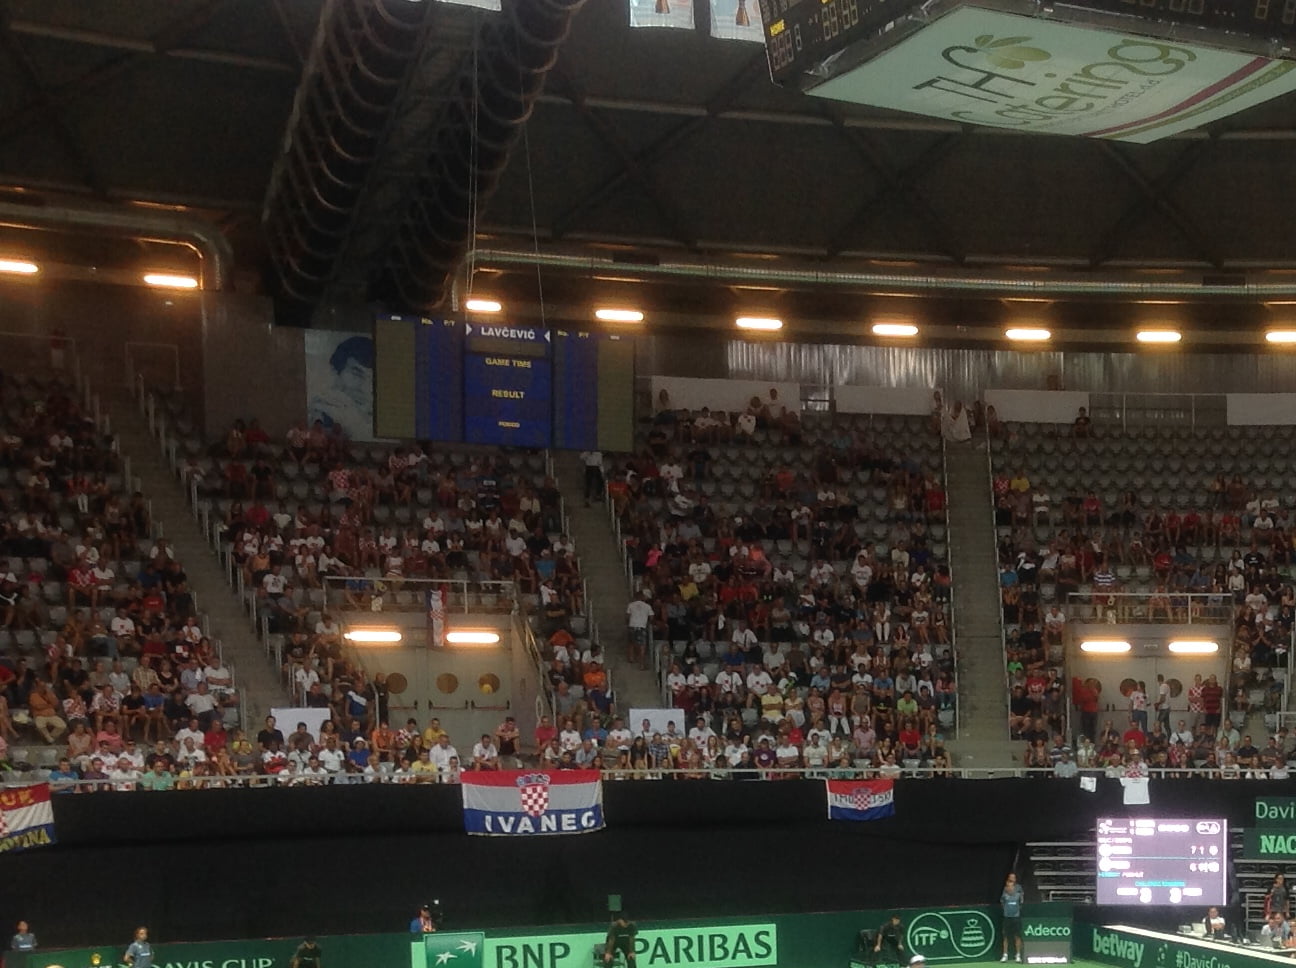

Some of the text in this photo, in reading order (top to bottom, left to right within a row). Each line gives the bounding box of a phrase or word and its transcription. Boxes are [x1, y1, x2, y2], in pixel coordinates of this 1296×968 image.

[481, 325, 535, 341] LAVČEVIĆ
[1024, 924, 1071, 937] Adecco
[915, 933, 938, 946] ITF
[634, 930, 773, 966] PARIBAS
[1093, 928, 1145, 968] betway
